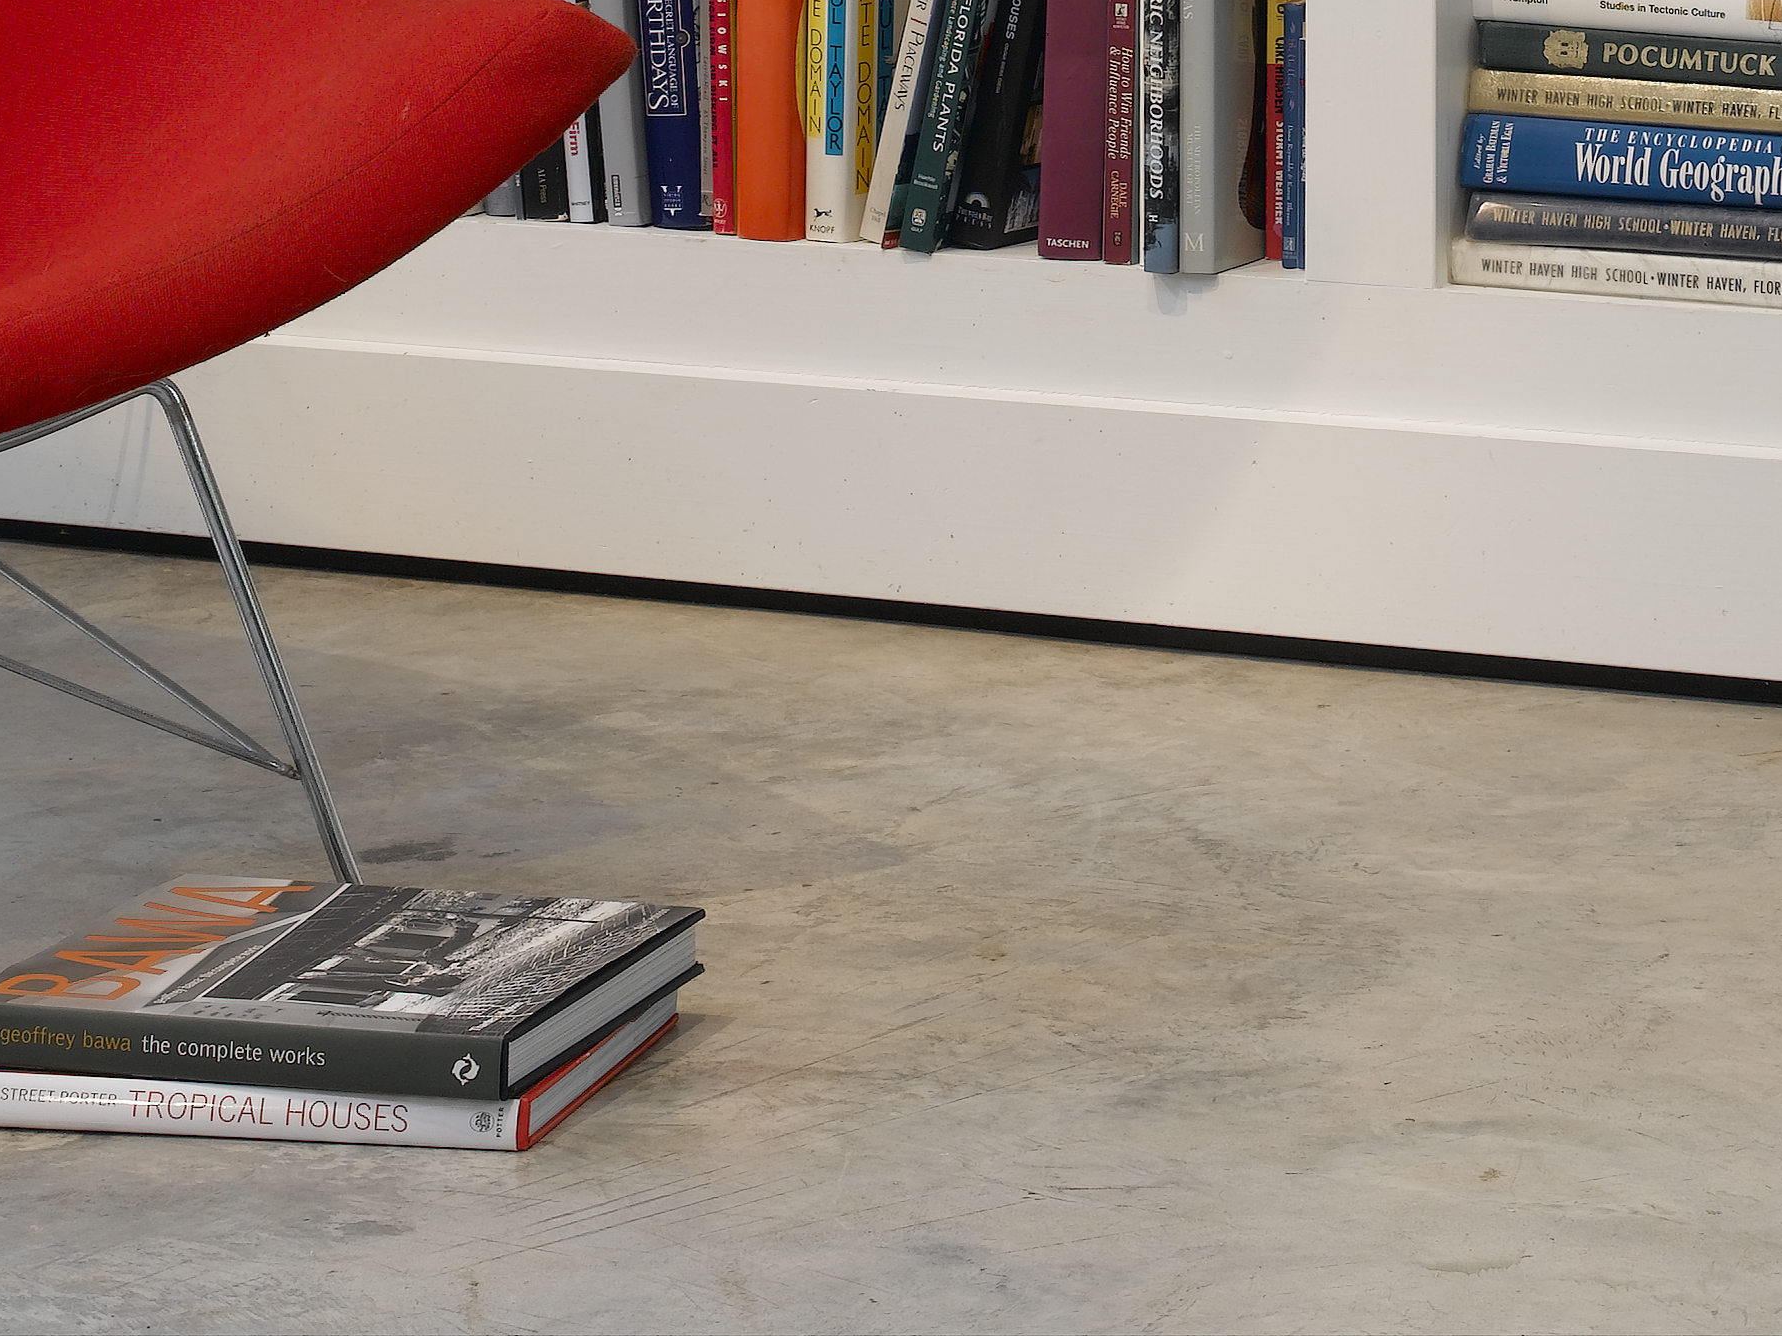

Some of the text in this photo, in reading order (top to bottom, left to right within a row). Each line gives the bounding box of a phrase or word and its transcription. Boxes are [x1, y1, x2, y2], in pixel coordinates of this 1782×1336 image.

[1602, 43, 1777, 77] POCUMTUCK
[932, 81, 956, 153] PLANTS
[1575, 143, 1651, 188] World
[1045, 237, 1090, 251] TASCHEN
[0, 1022, 327, 1068] geoffrey bawa the complete works
[129, 1088, 410, 1134] TROPICAL HOUSES
